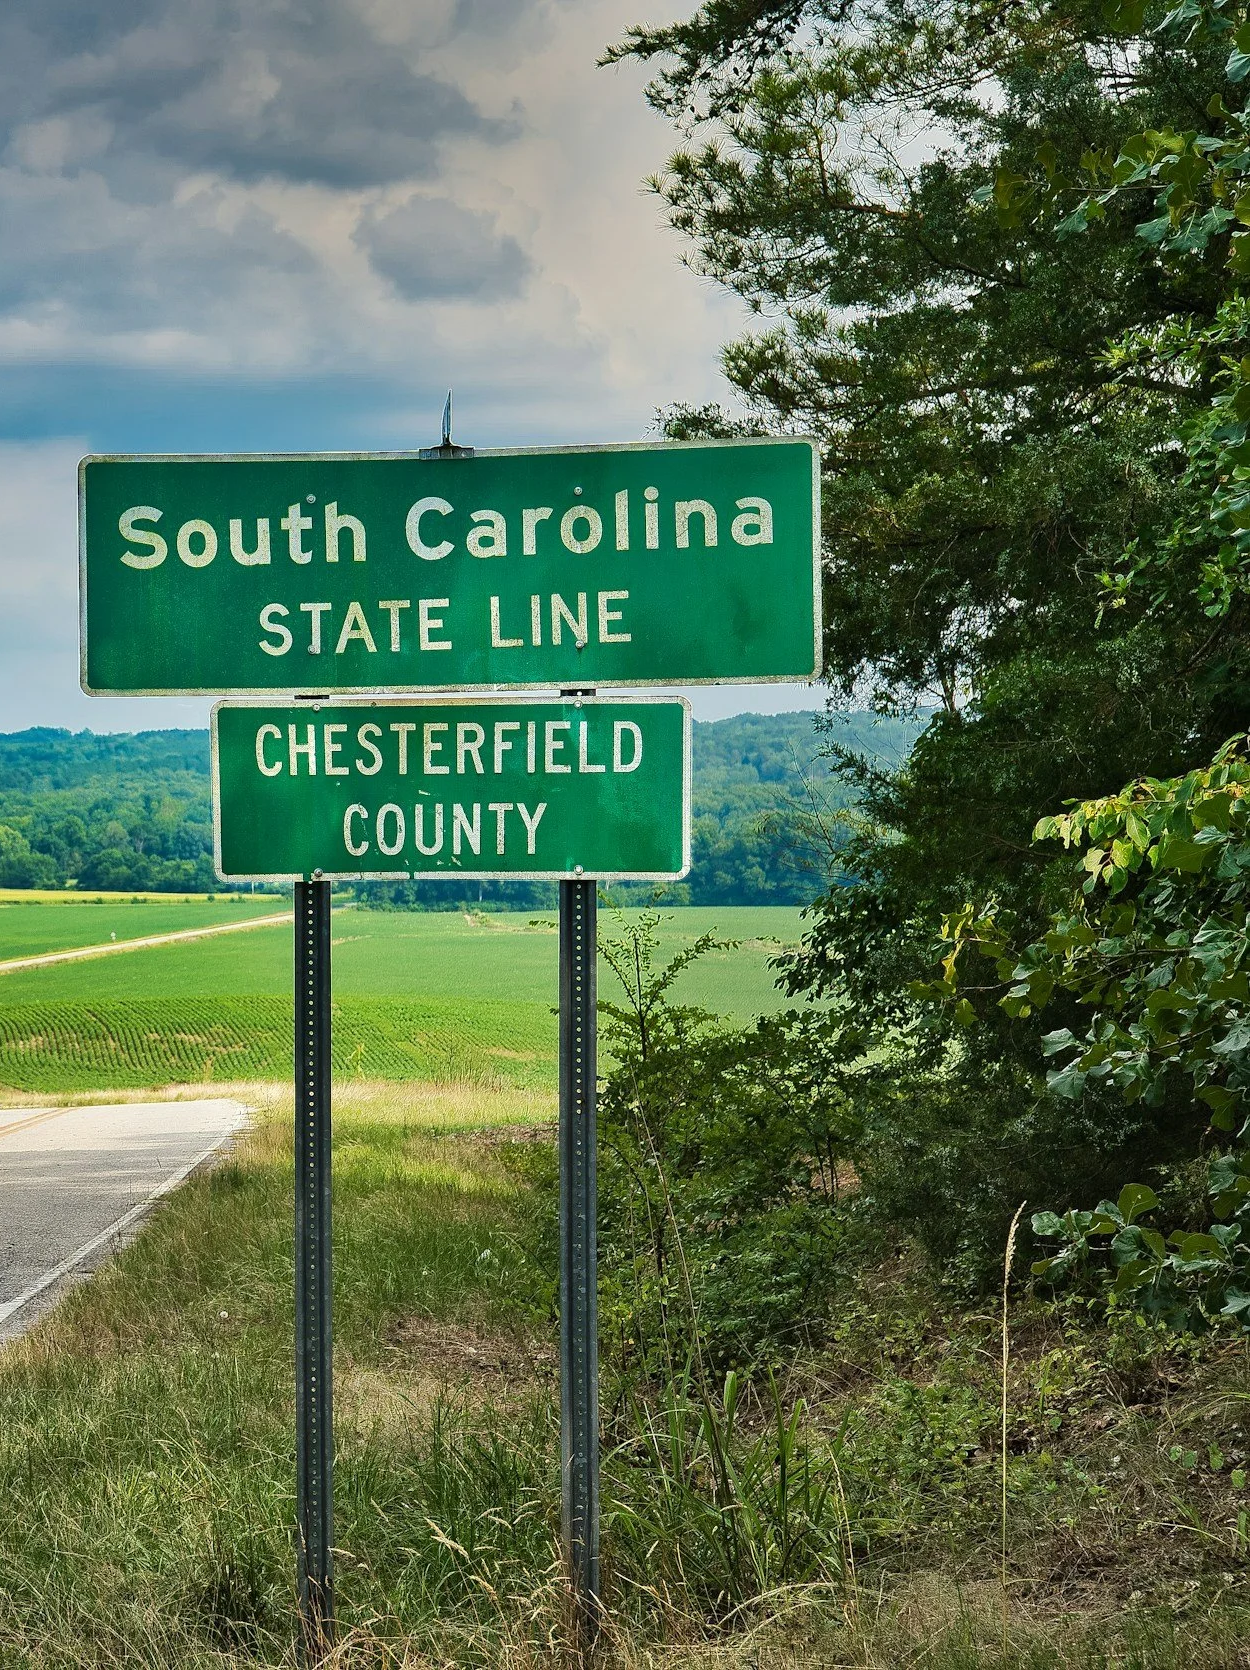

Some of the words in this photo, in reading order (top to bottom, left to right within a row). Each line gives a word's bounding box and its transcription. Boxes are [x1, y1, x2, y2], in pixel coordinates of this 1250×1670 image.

[118, 500, 368, 570] South
[405, 486, 775, 561] Carolina
[259, 598, 453, 656] STATE
[490, 589, 632, 648] LINE
[255, 721, 643, 777] CHESTERFIELD
[344, 802, 548, 858] COUNTY
